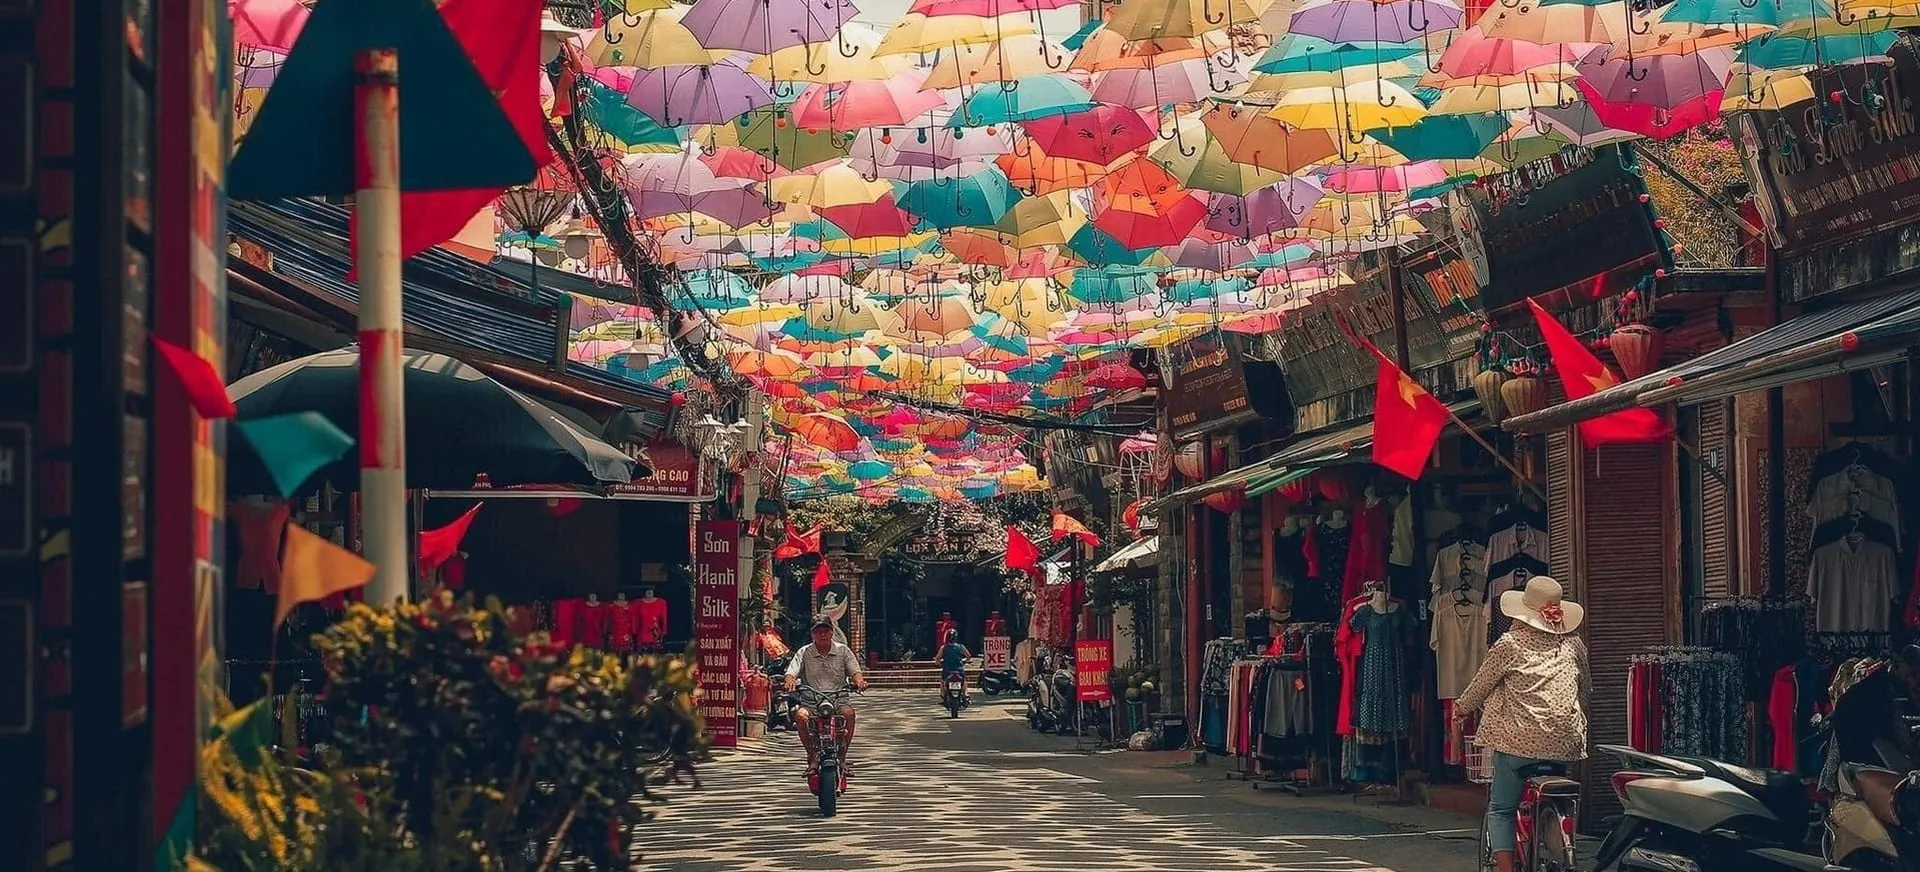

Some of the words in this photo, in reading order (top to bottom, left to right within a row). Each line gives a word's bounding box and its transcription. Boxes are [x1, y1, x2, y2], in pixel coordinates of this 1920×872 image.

[669, 470, 689, 482] CAO
[704, 532, 729, 553] Sơn
[700, 564, 735, 588] Hạnh
[703, 596, 730, 617] Silk
[987, 653, 1005, 663] XE
[1099, 647, 1107, 660] XE
[725, 706, 735, 717] CAO
